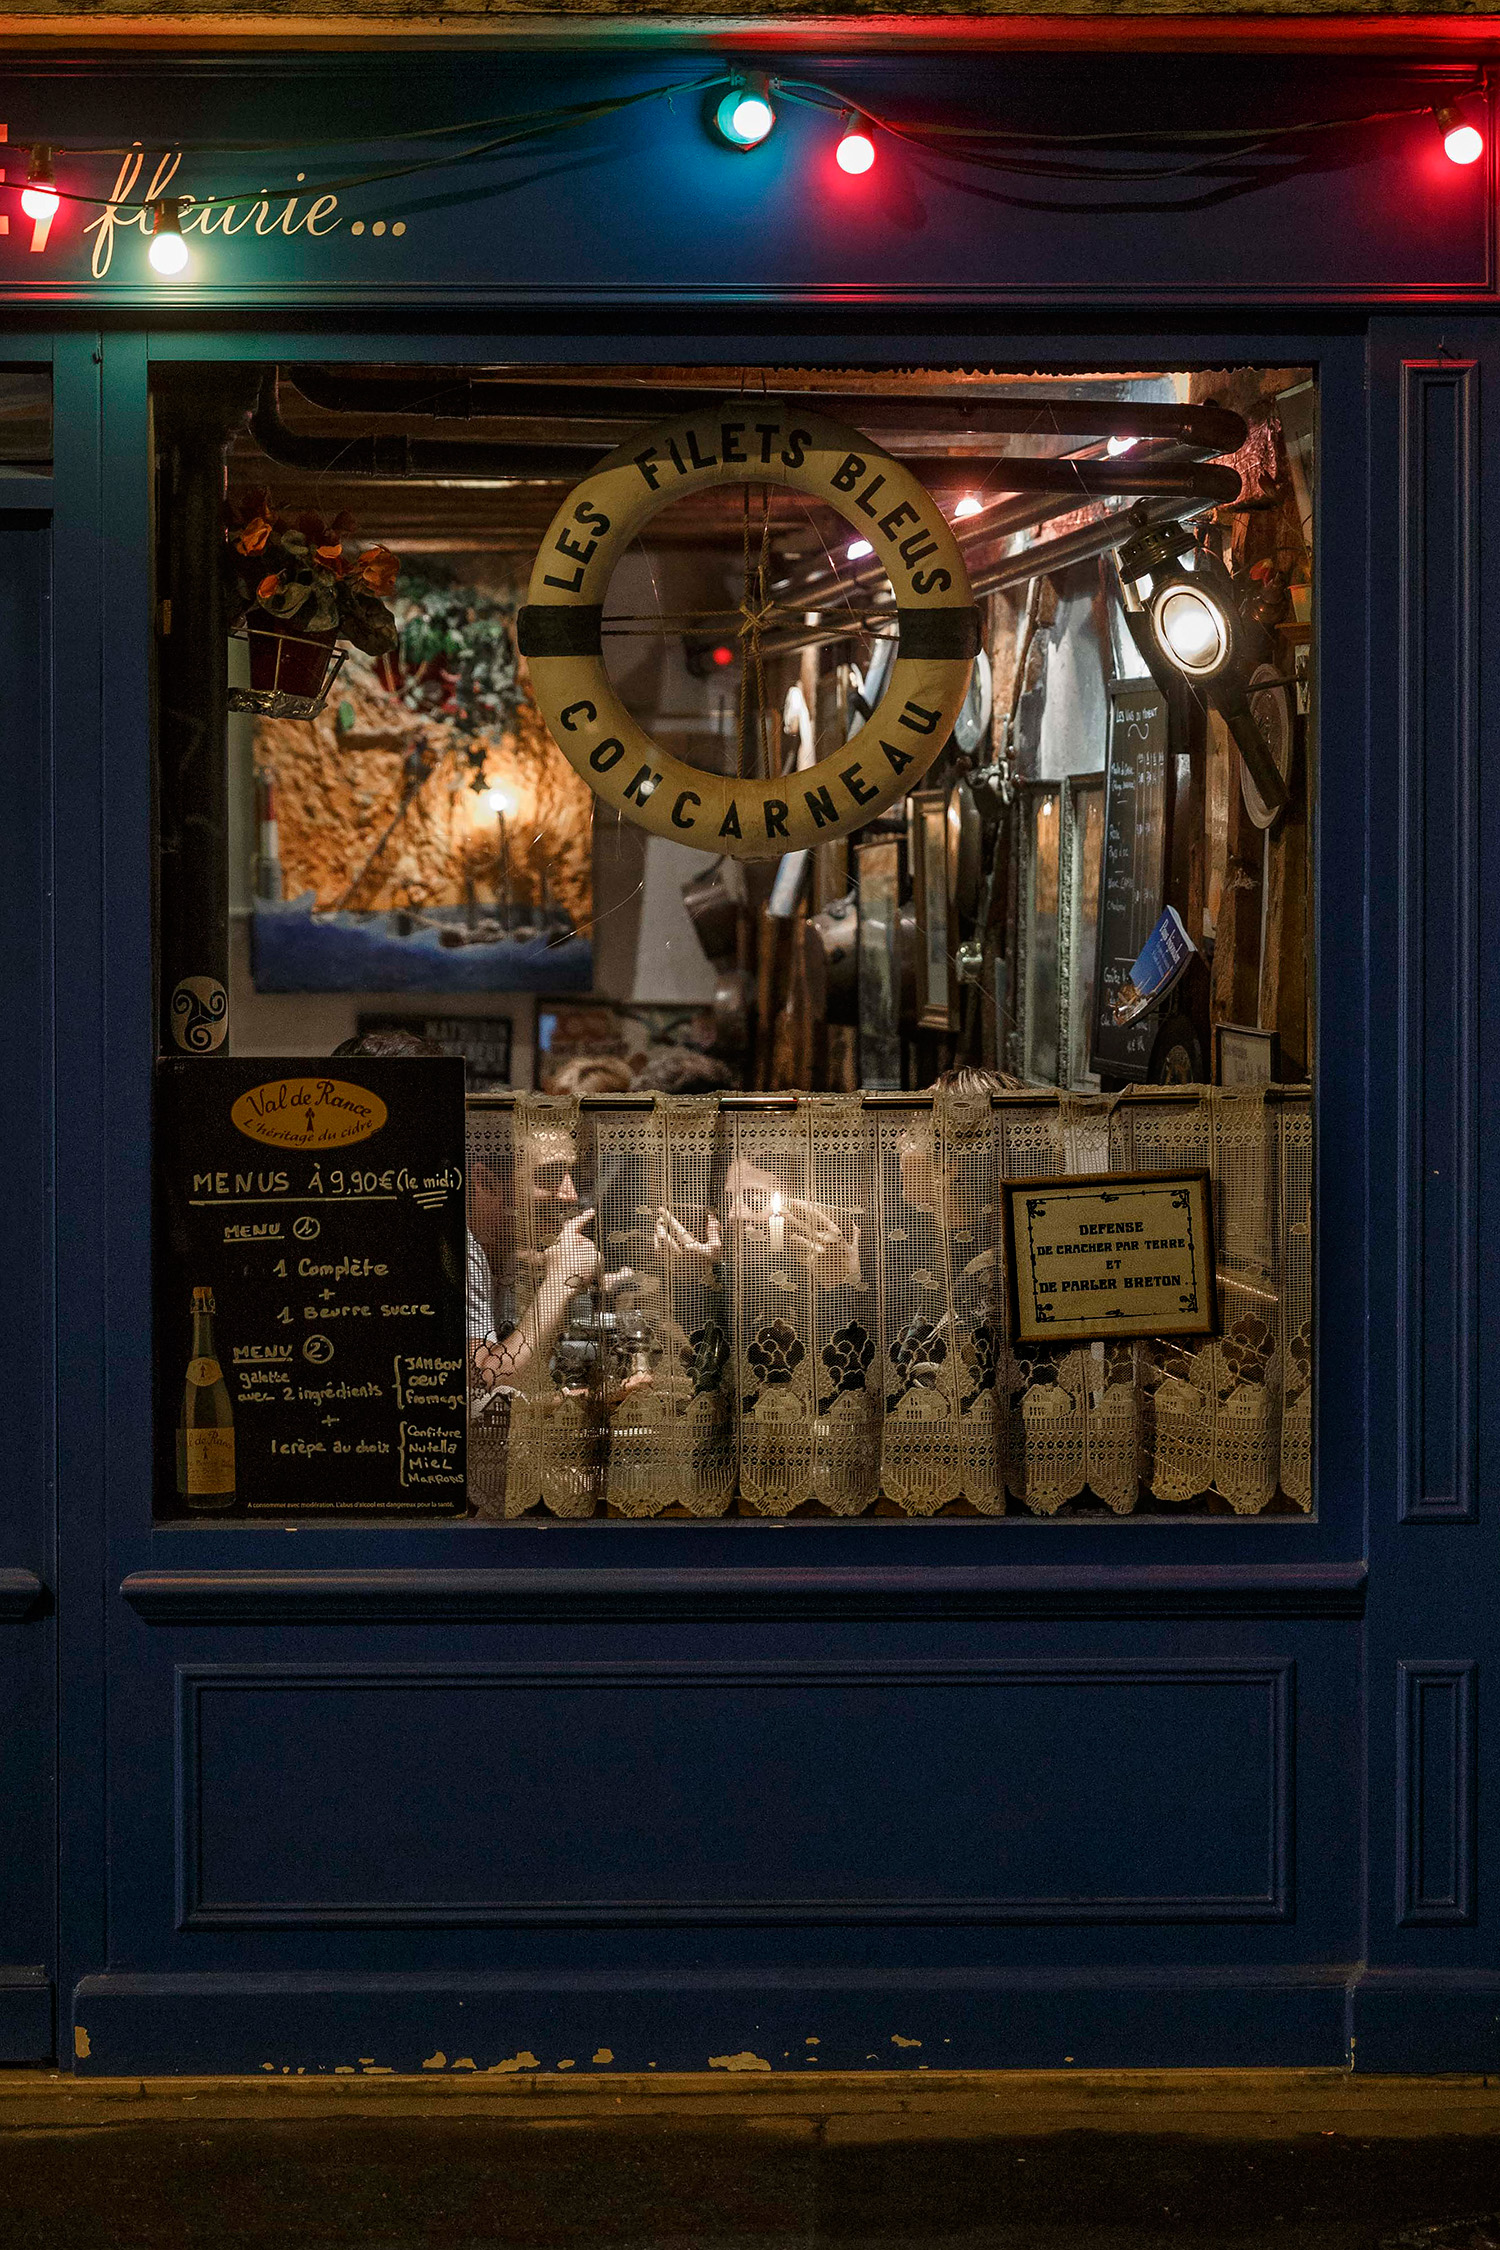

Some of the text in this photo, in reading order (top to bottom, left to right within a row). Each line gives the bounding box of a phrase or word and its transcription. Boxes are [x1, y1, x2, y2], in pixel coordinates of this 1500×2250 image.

[543, 422, 952, 596] LES FILETS BLEUS
[560, 699, 942, 840] CONCARNEAU
[246, 1080, 372, 1118] Val de Rance
[243, 1118, 373, 1147] L'héritage du cidre
[193, 1171, 291, 1194] MENUS
[423, 1167, 463, 1191] midi)
[224, 1222, 281, 1238] MENU
[1079, 1221, 1144, 1236] DEFENSE
[1037, 1238, 1186, 1256] DE CRACHER PAR TERRE
[273, 1256, 389, 1281] 1 Complète
[1106, 1260, 1122, 1270] ET
[1039, 1281, 1057, 1293] DE
[1061, 1279, 1118, 1292] PARLER
[277, 1306, 294, 1324] 1
[303, 1305, 372, 1320] Beurre
[232, 1344, 293, 1360] MENU
[283, 1386, 296, 1401] 2
[407, 1425, 463, 1439] Confiture
[408, 1439, 458, 1454] Nutella
